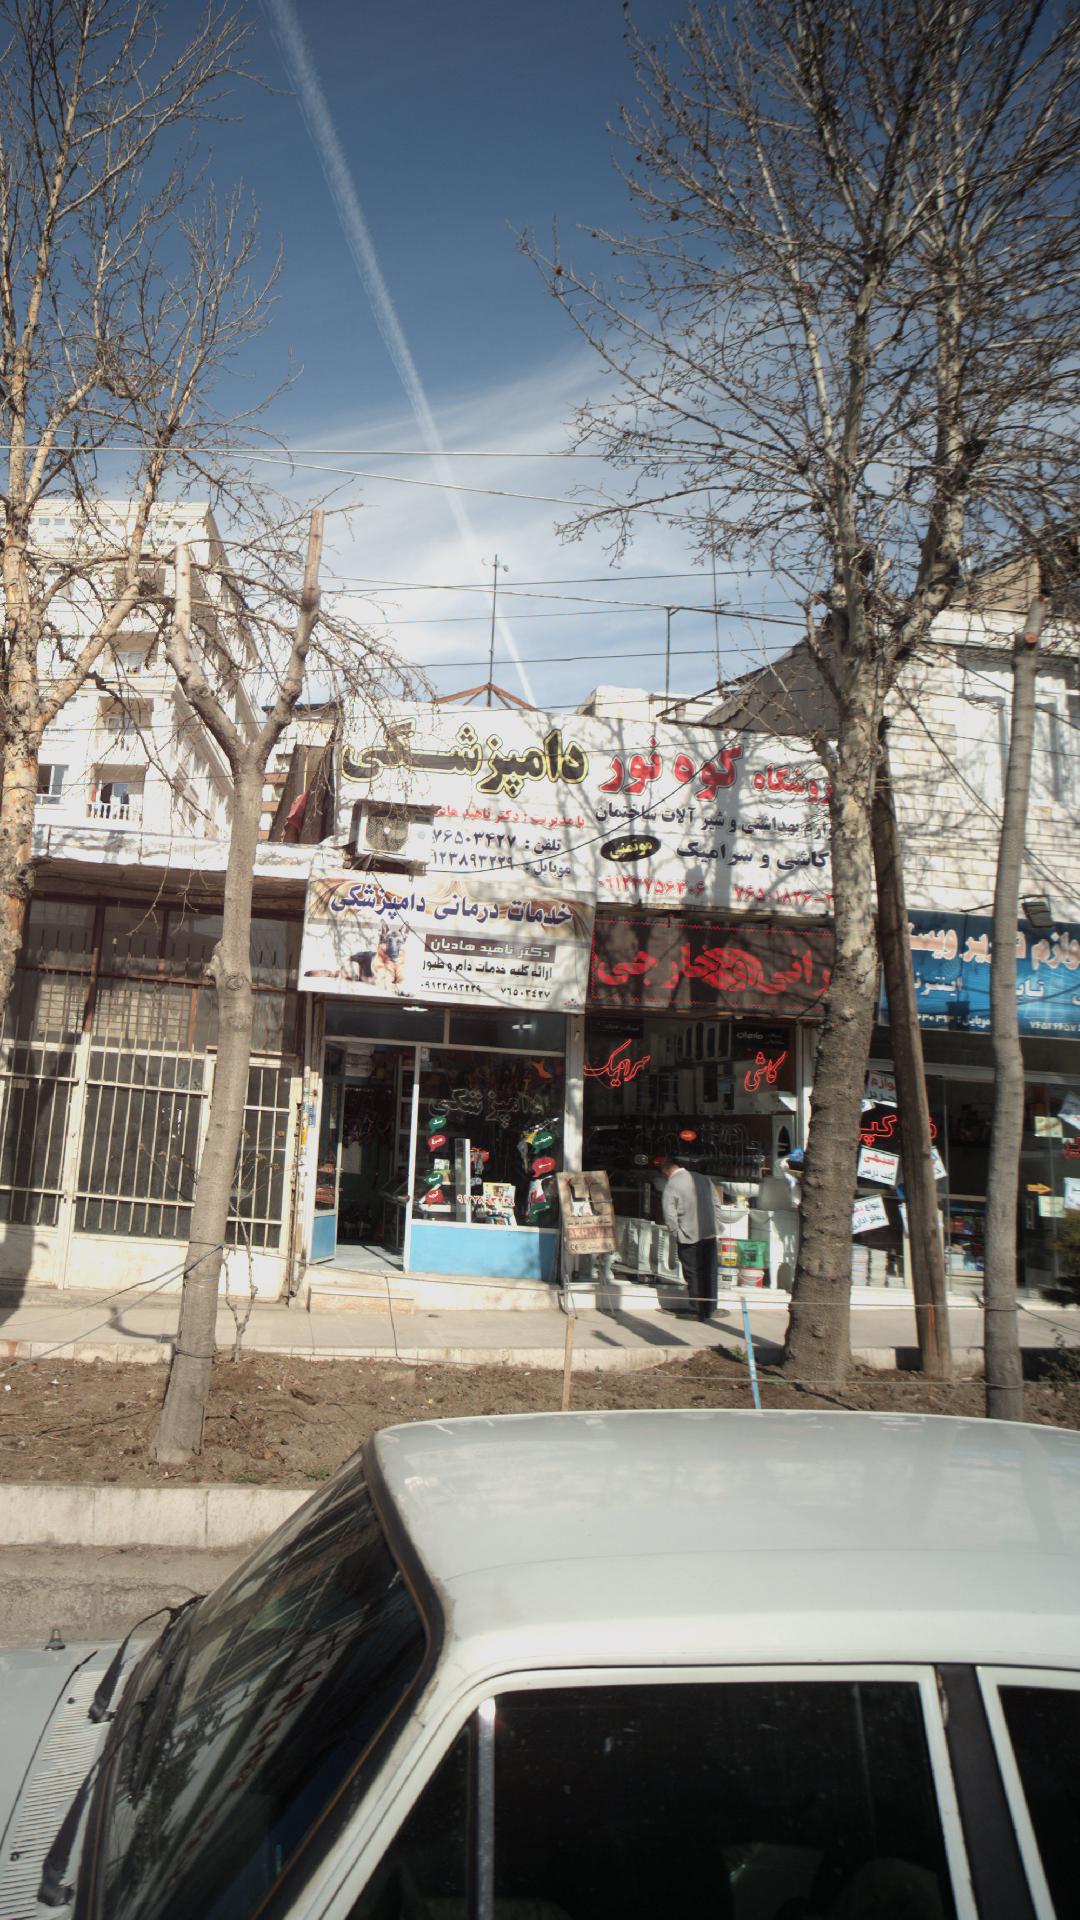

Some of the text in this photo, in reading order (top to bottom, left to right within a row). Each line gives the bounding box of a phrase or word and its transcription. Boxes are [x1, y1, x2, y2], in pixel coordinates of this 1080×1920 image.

[341, 718, 589, 798] دامپزشکی
[599, 735, 663, 795] نور
[753, 763, 833, 805] روشگاه
[463, 806, 491, 820] ناهید
[495, 809, 519, 824] دکتر
[577, 815, 585, 828] با
[595, 803, 656, 822] ساختمان
[701, 811, 725, 832] شیر
[728, 819, 736, 833] و
[433, 829, 516, 848] ۷۶۵۰۳۴۲۷
[676, 841, 829, 870] کاشی و سرامیک
[330, 883, 573, 926] خدمات درمانی دامپزشکی
[430, 938, 550, 959] دکتر ناهید هادیان
[422, 957, 446, 970] طیور
[447, 962, 453, 972] و
[455, 959, 473, 972] دام
[475, 962, 506, 975] خدمات
[509, 964, 529, 977] کلیه
[583, 1039, 651, 1087] سرامیک
[744, 1050, 788, 1093] کاشی
